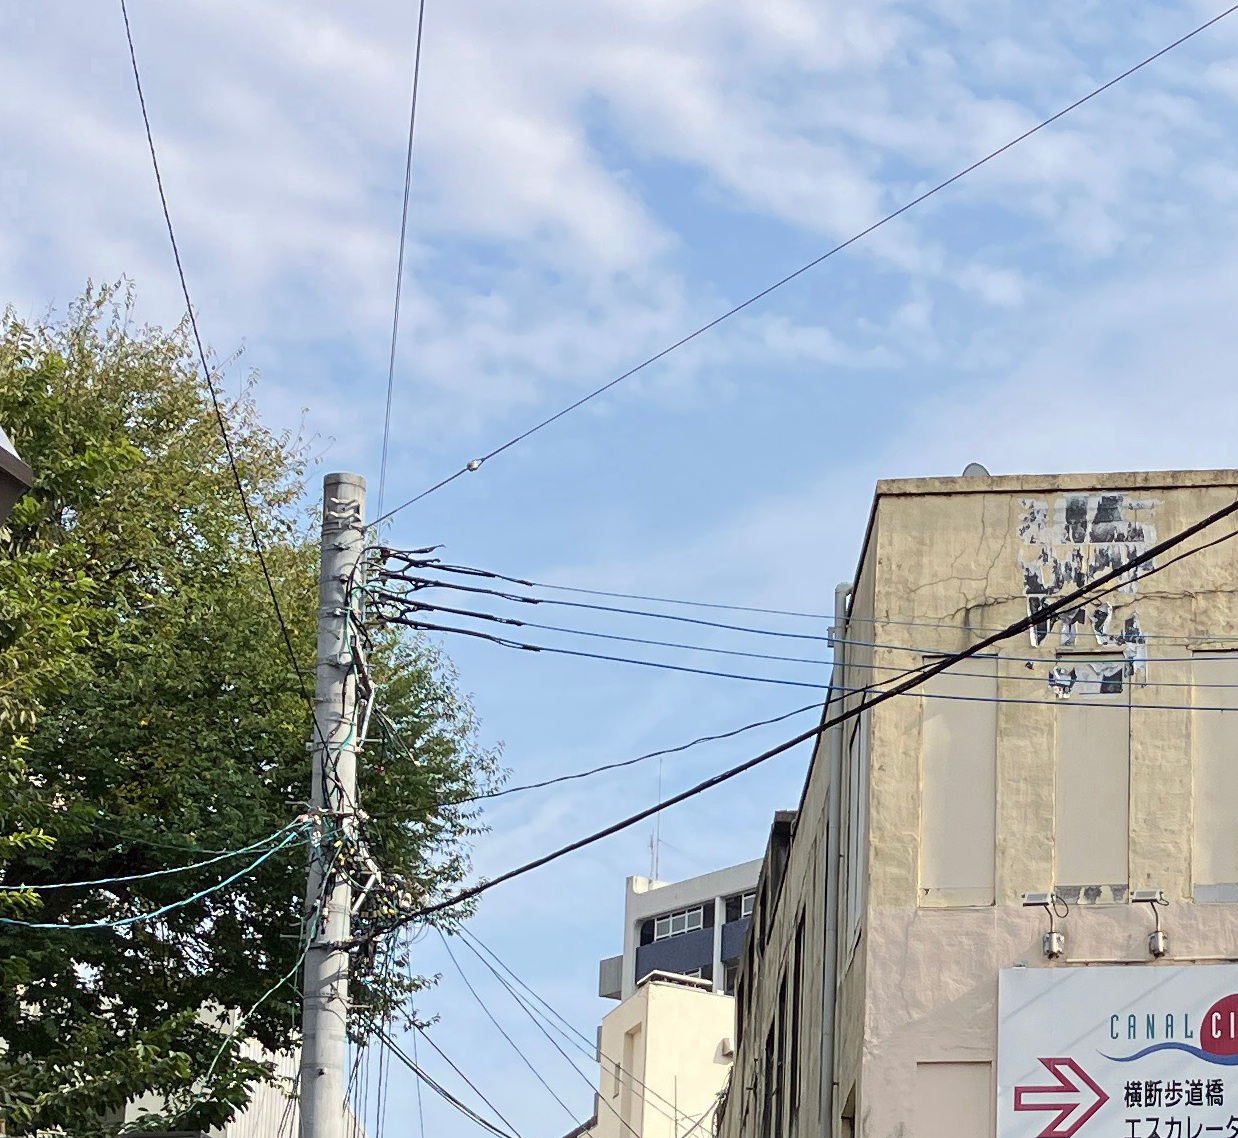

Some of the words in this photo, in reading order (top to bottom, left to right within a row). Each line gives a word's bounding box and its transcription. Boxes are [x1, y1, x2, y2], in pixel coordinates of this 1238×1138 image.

[1110, 1013, 1194, 1039] CANAL
[1124, 1079, 1224, 1107] 横断歩道橋
